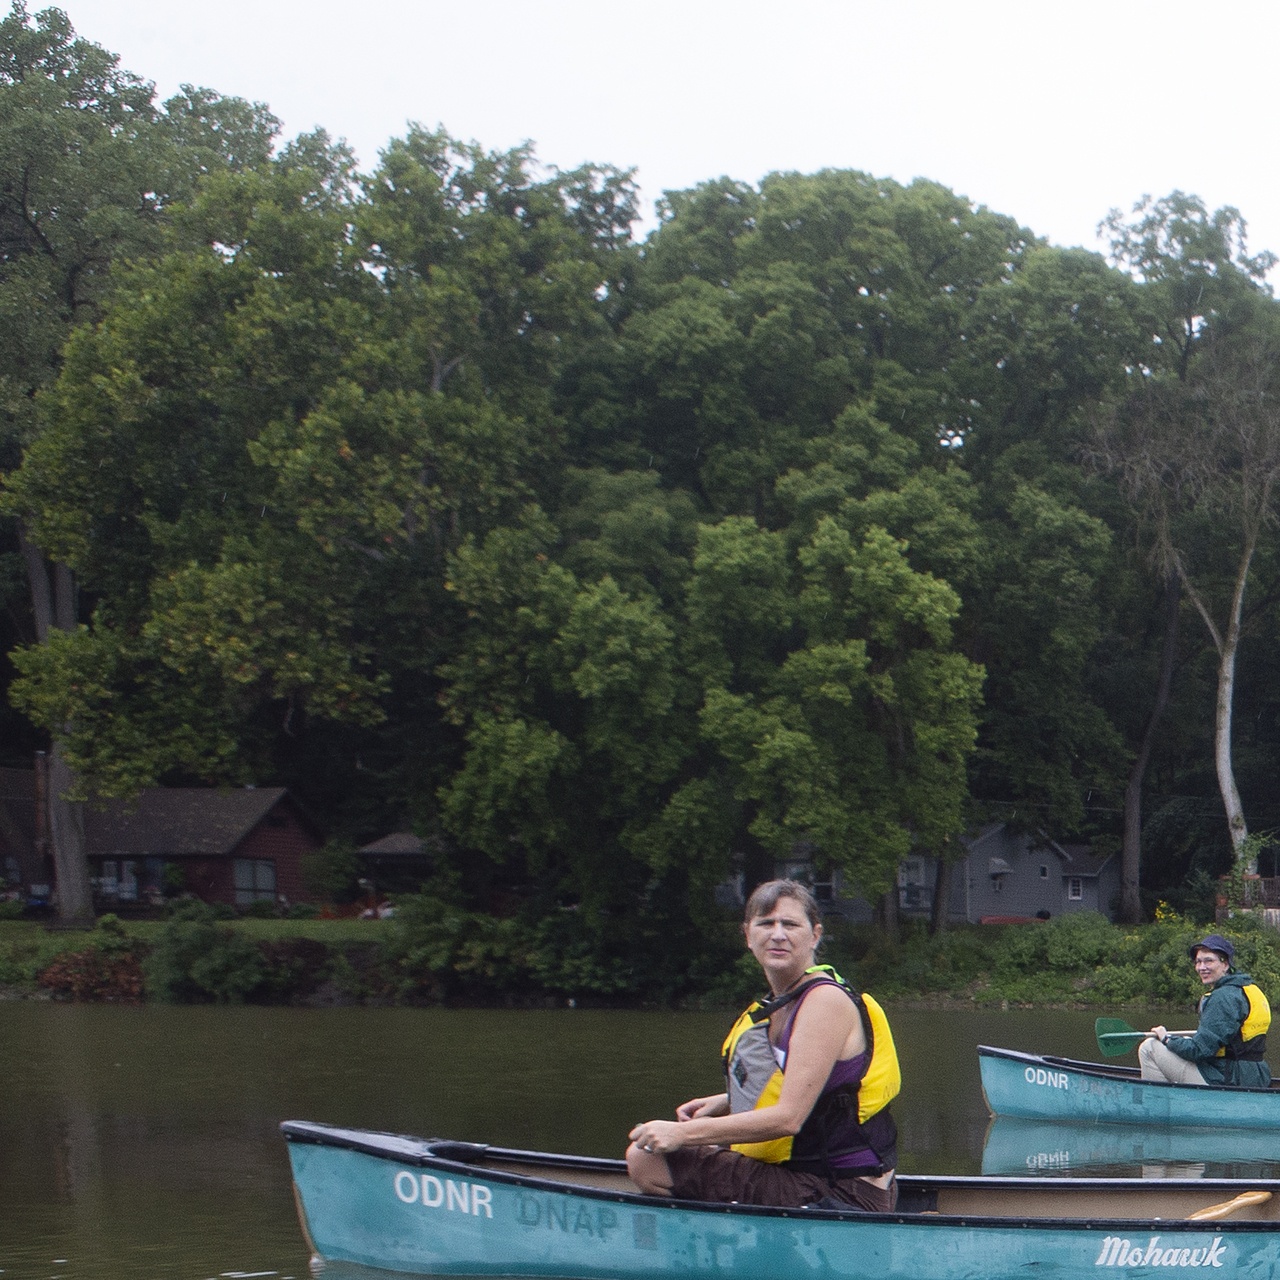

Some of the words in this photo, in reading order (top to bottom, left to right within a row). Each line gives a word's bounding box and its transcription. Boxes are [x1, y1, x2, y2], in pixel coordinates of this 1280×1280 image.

[1024, 1067, 1068, 1090] ODNR
[394, 1171, 493, 1218] ODNR
[518, 1192, 618, 1241] DNAP
[1095, 1236, 1227, 1267] Mohawk
